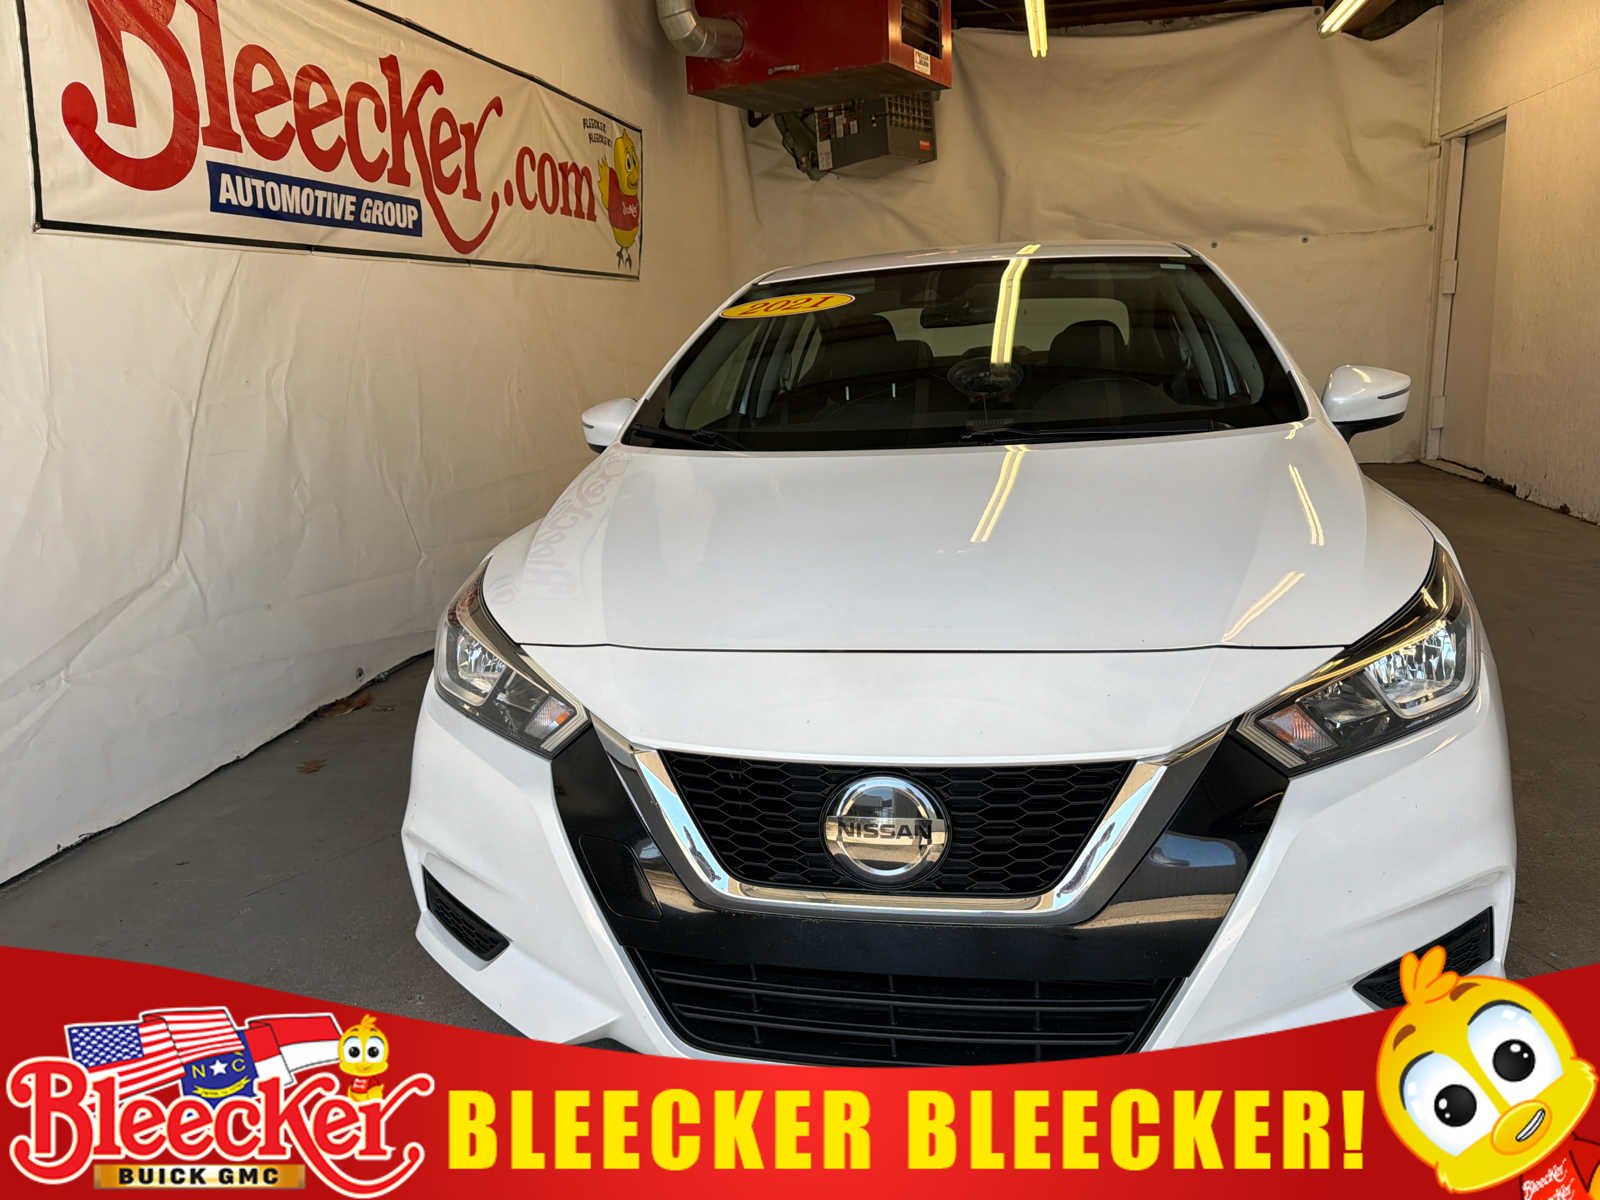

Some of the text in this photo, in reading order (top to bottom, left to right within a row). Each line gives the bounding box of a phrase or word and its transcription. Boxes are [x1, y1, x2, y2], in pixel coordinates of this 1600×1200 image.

[219, 173, 419, 229] AUTOMOTIVE GROUP
[737, 295, 835, 316] 2021
[837, 820, 933, 842] NISSAN
